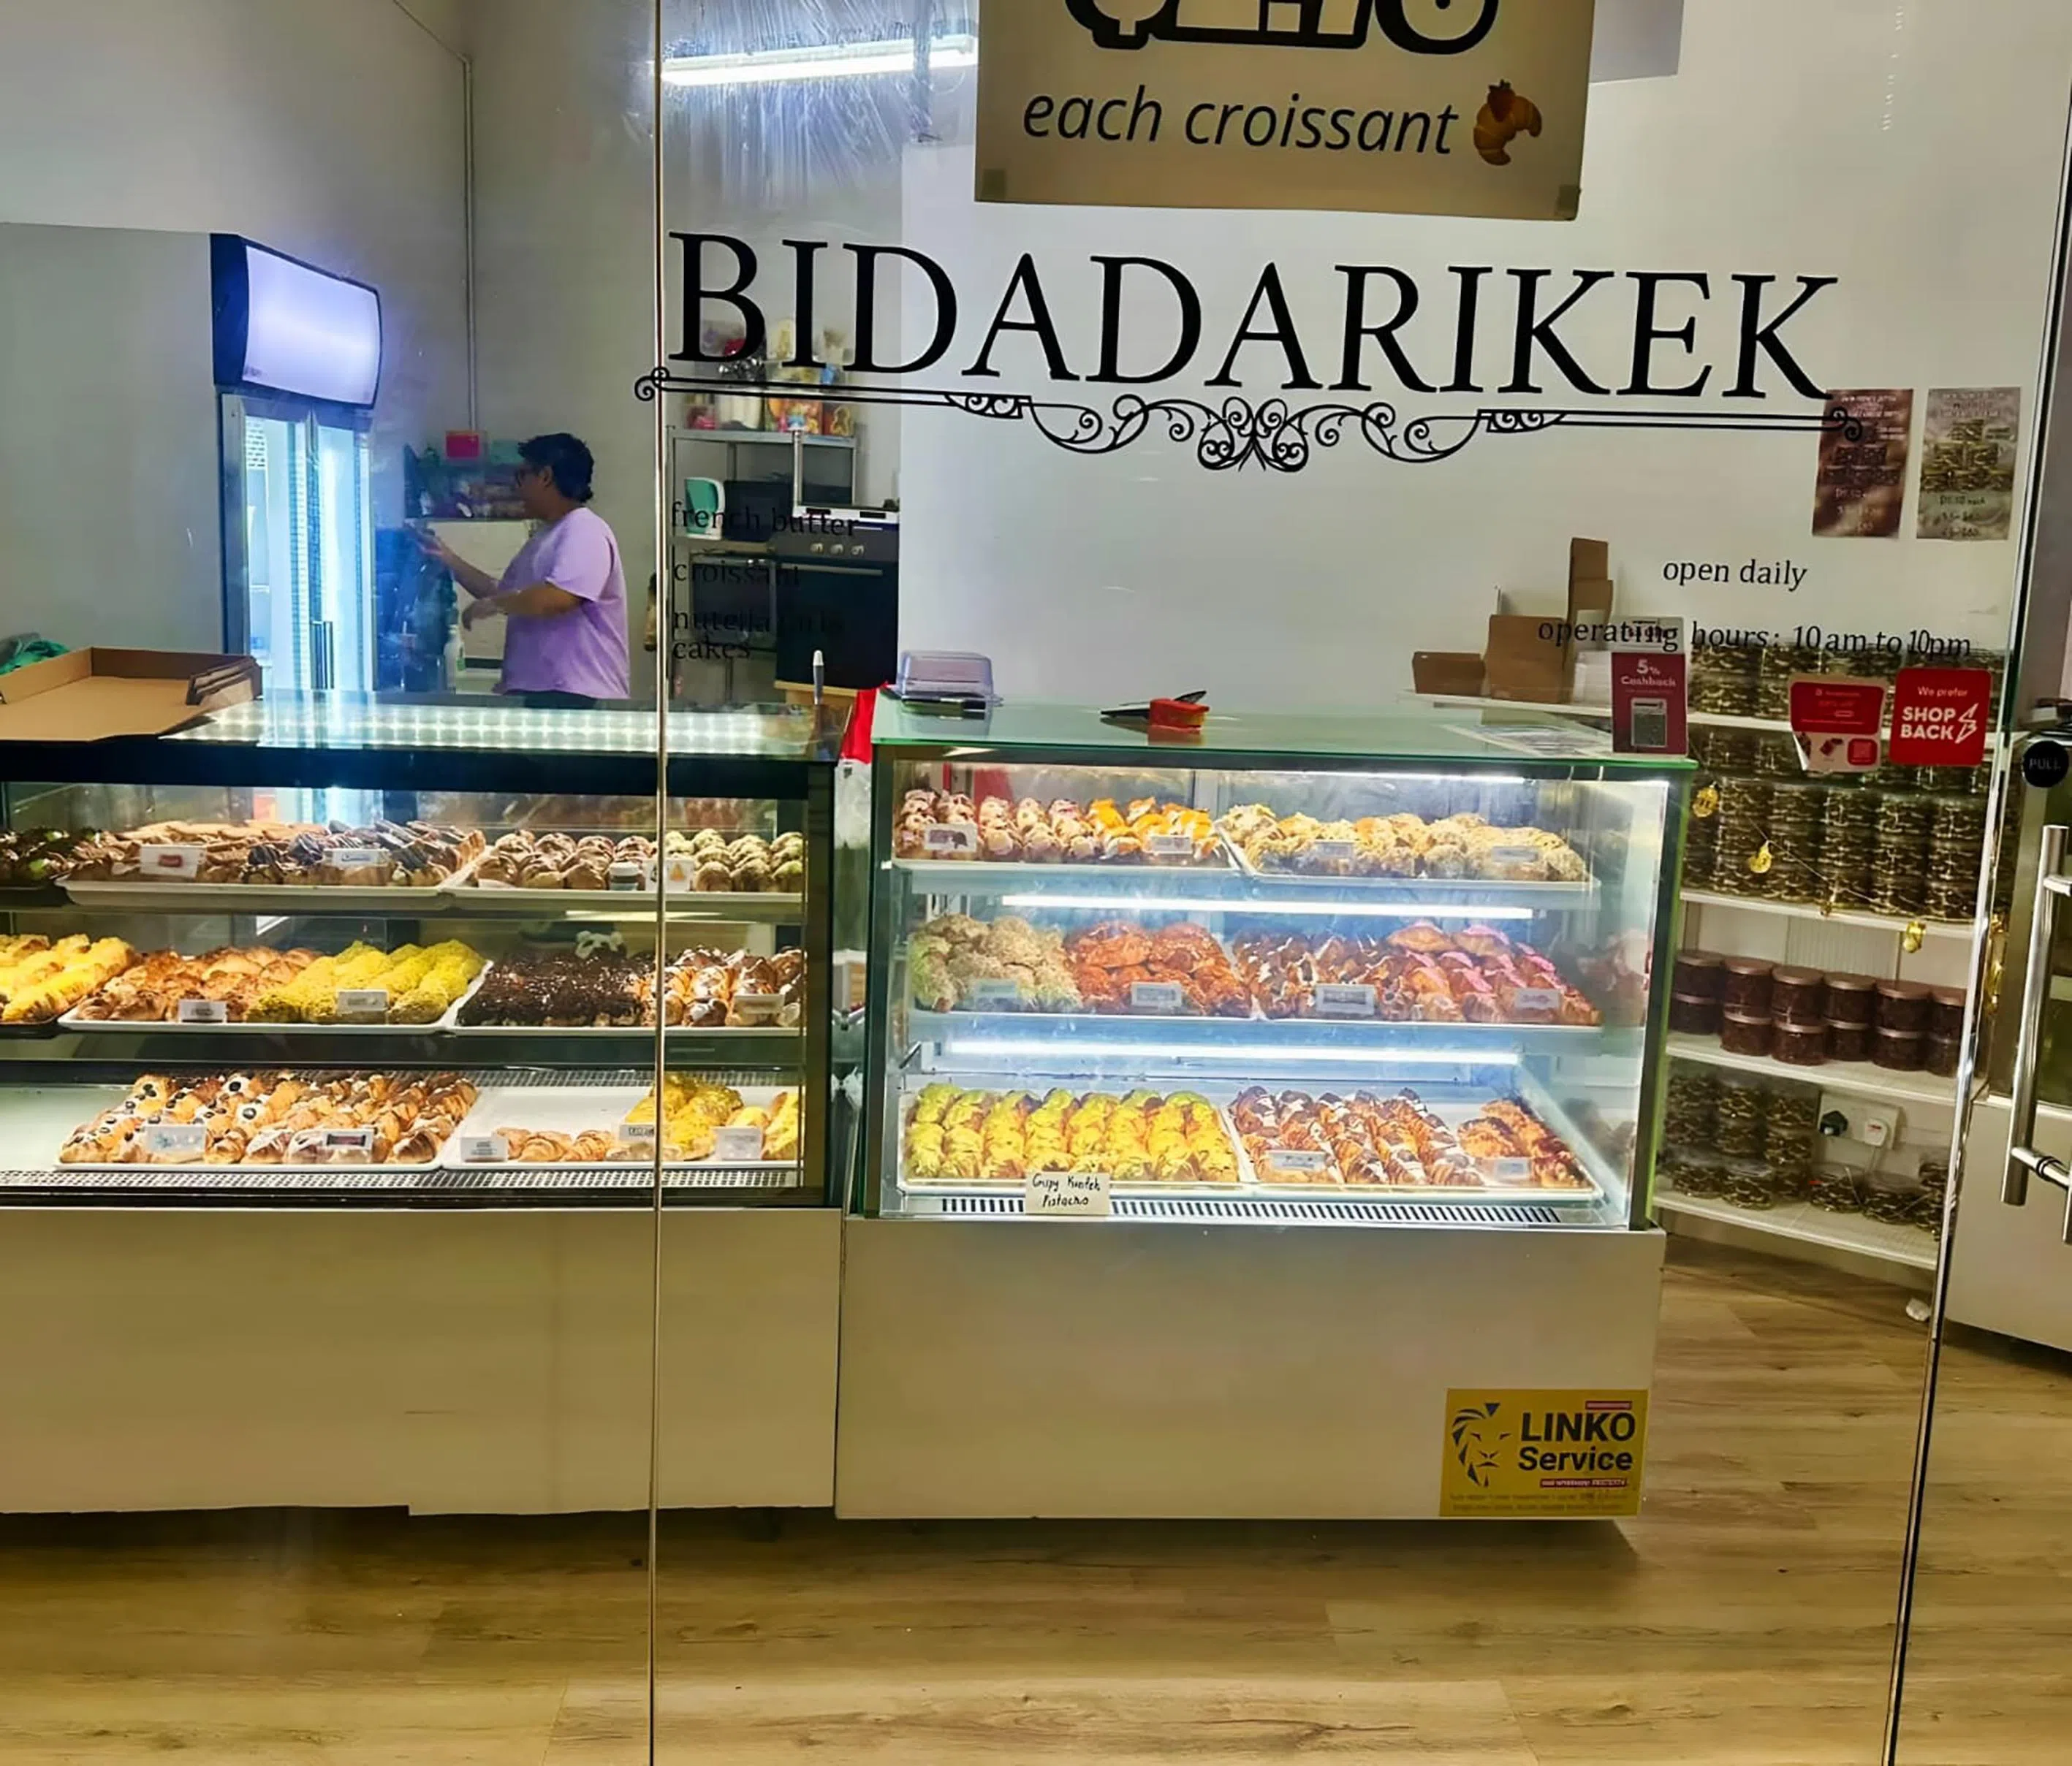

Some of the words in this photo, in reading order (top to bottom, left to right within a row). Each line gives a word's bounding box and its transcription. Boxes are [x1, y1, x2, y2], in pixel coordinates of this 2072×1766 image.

[1023, 85, 1162, 142] each
[1185, 94, 1459, 154] croissant
[669, 232, 1837, 399] BIDADARIKEK
[672, 501, 760, 530] french
[772, 506, 858, 536] butter
[1663, 560, 1729, 586] open
[1740, 559, 1807, 591] daily
[673, 634, 751, 660] cakes
[1538, 622, 1679, 652] operating
[1691, 622, 1780, 649] hours:
[1876, 631, 1902, 653] to
[1917, 686, 1935, 697] We
[1902, 707, 1957, 723] SHOP
[1900, 725, 1954, 741] BACK
[2029, 758, 2061, 770] PULL
[1521, 1412, 1636, 1442] LINKO
[1518, 1446, 1632, 1471] Service
